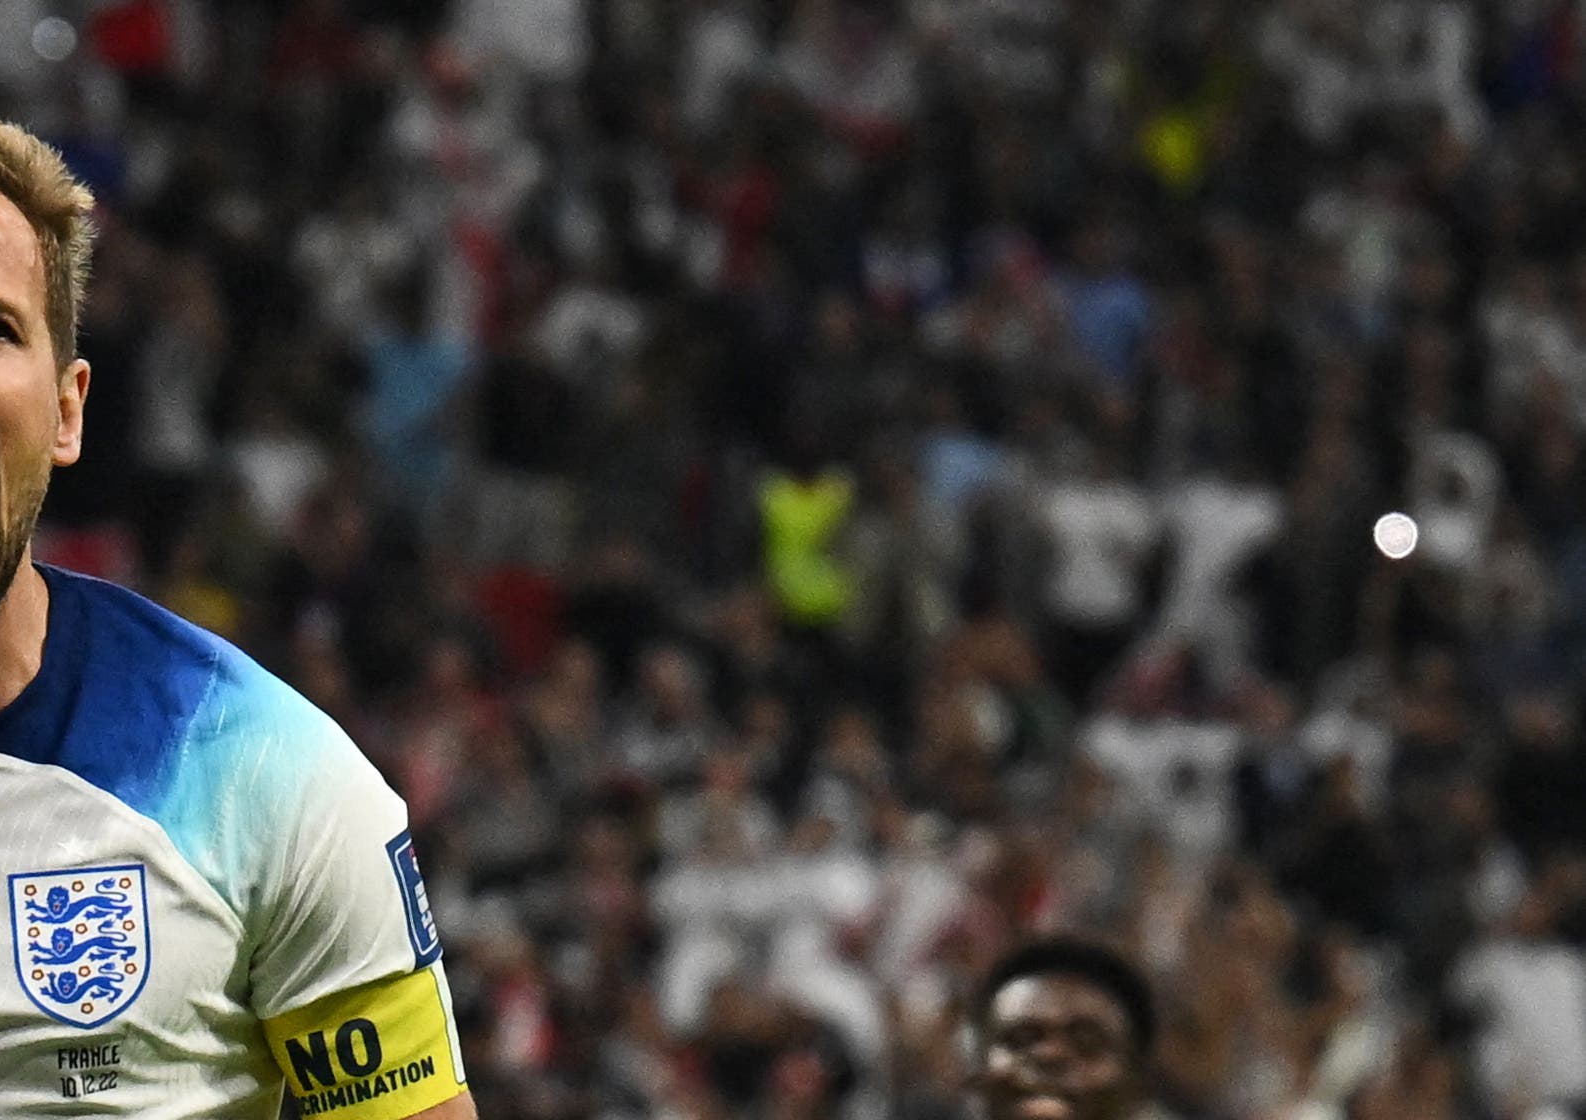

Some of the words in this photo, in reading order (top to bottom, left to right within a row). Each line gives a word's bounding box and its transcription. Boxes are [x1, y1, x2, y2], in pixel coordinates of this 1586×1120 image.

[57, 1045, 121, 1069] FRANCE
[285, 1017, 382, 1091] NO
[60, 1071, 118, 1098] 10.12.22
